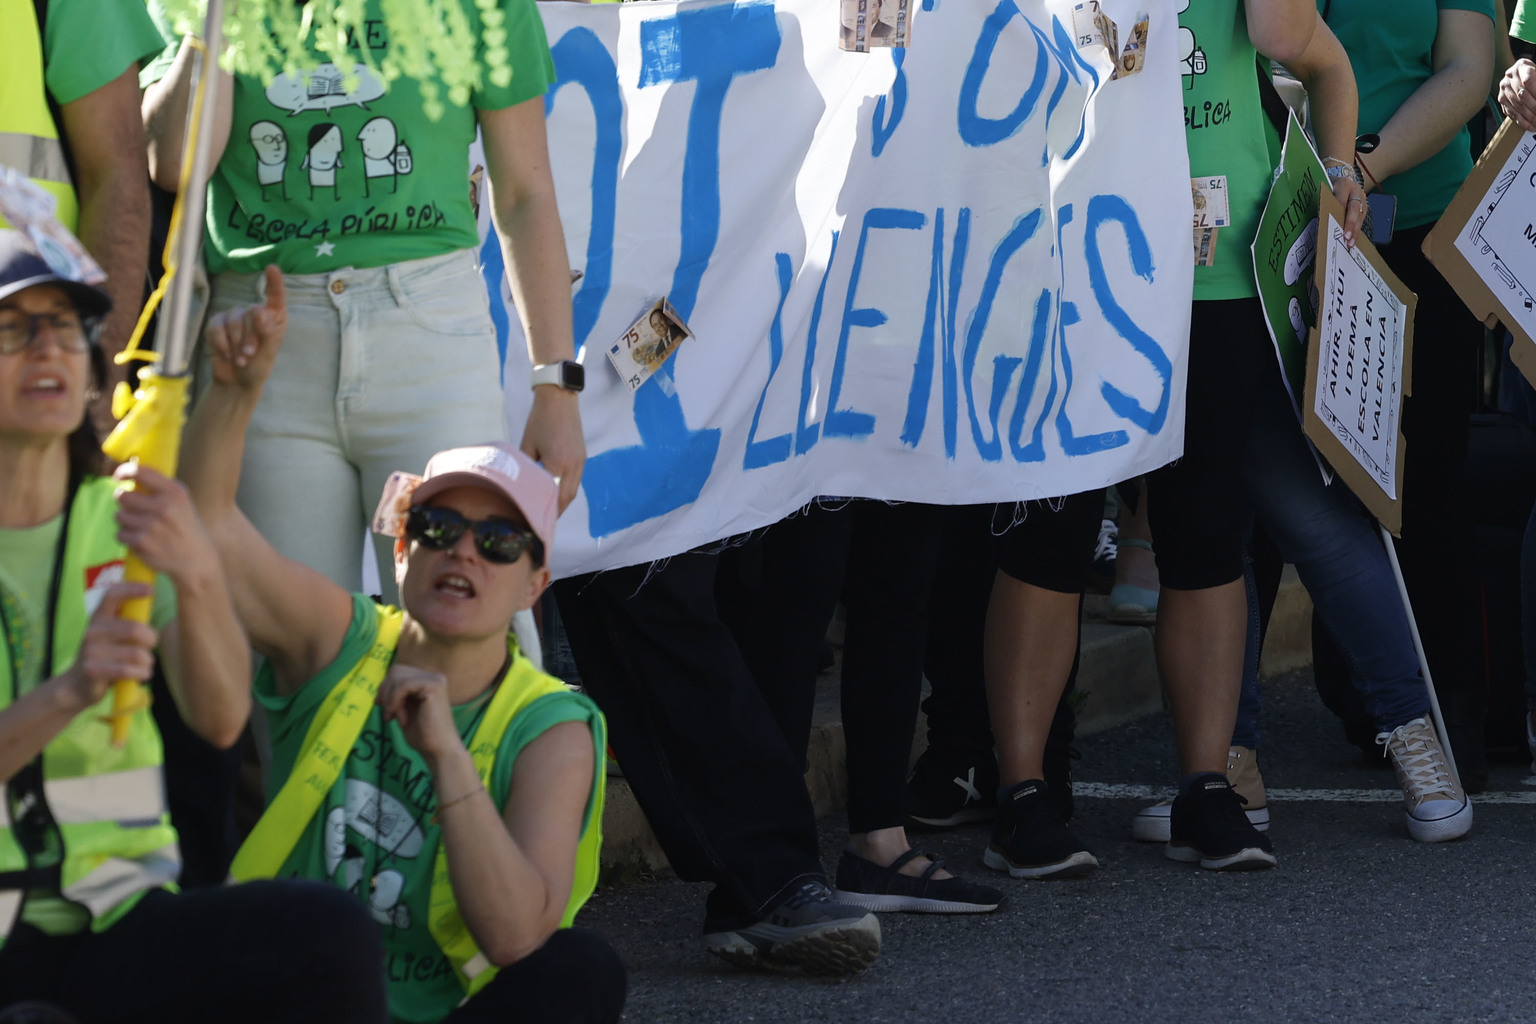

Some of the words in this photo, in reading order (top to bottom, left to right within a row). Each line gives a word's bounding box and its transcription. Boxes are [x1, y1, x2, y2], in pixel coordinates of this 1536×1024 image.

[1080, 35, 1092, 45] 75
[1336, 268, 1345, 317] HUI
[622, 328, 640, 348] 75
[1357, 336, 1372, 434] ESCOLA
[1365, 291, 1374, 328] EN
[629, 374, 641, 388] 75
[1344, 385, 1352, 396] I
